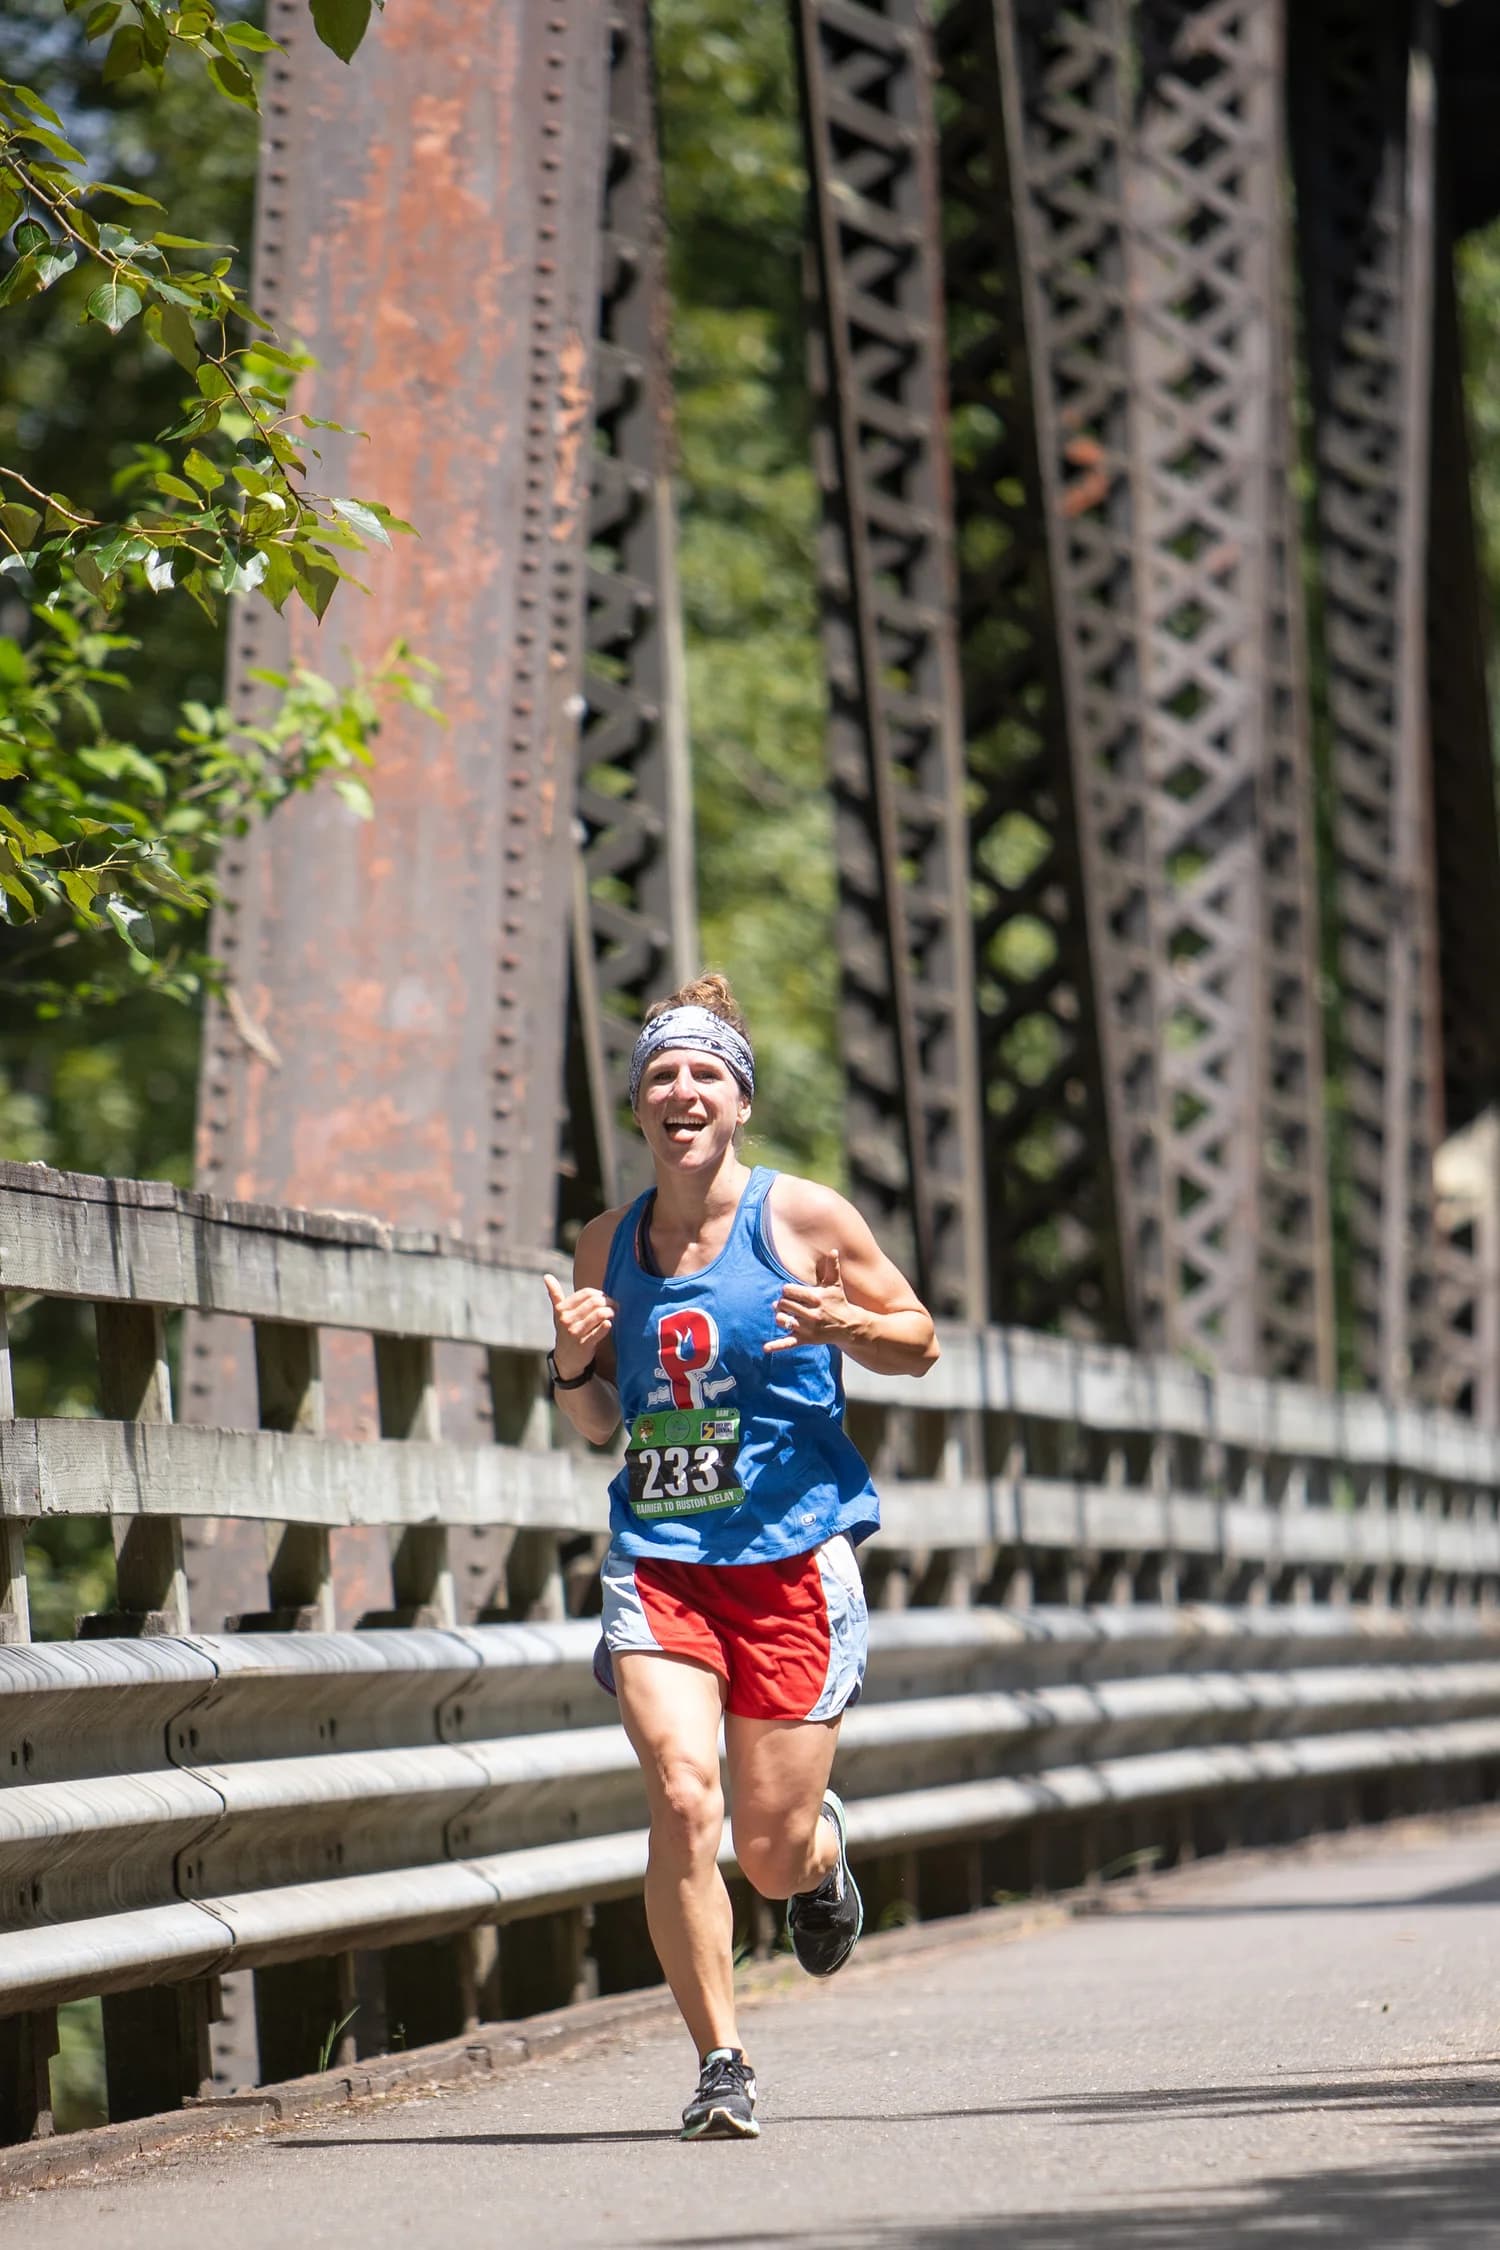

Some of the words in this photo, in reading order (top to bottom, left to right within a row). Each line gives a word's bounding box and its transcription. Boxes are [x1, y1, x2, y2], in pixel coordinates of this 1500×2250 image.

[639, 1446, 720, 1499] 233
[664, 1501, 674, 1512] TO
[675, 1496, 707, 1510] RUSTON
[708, 1491, 735, 1505] RELAY
